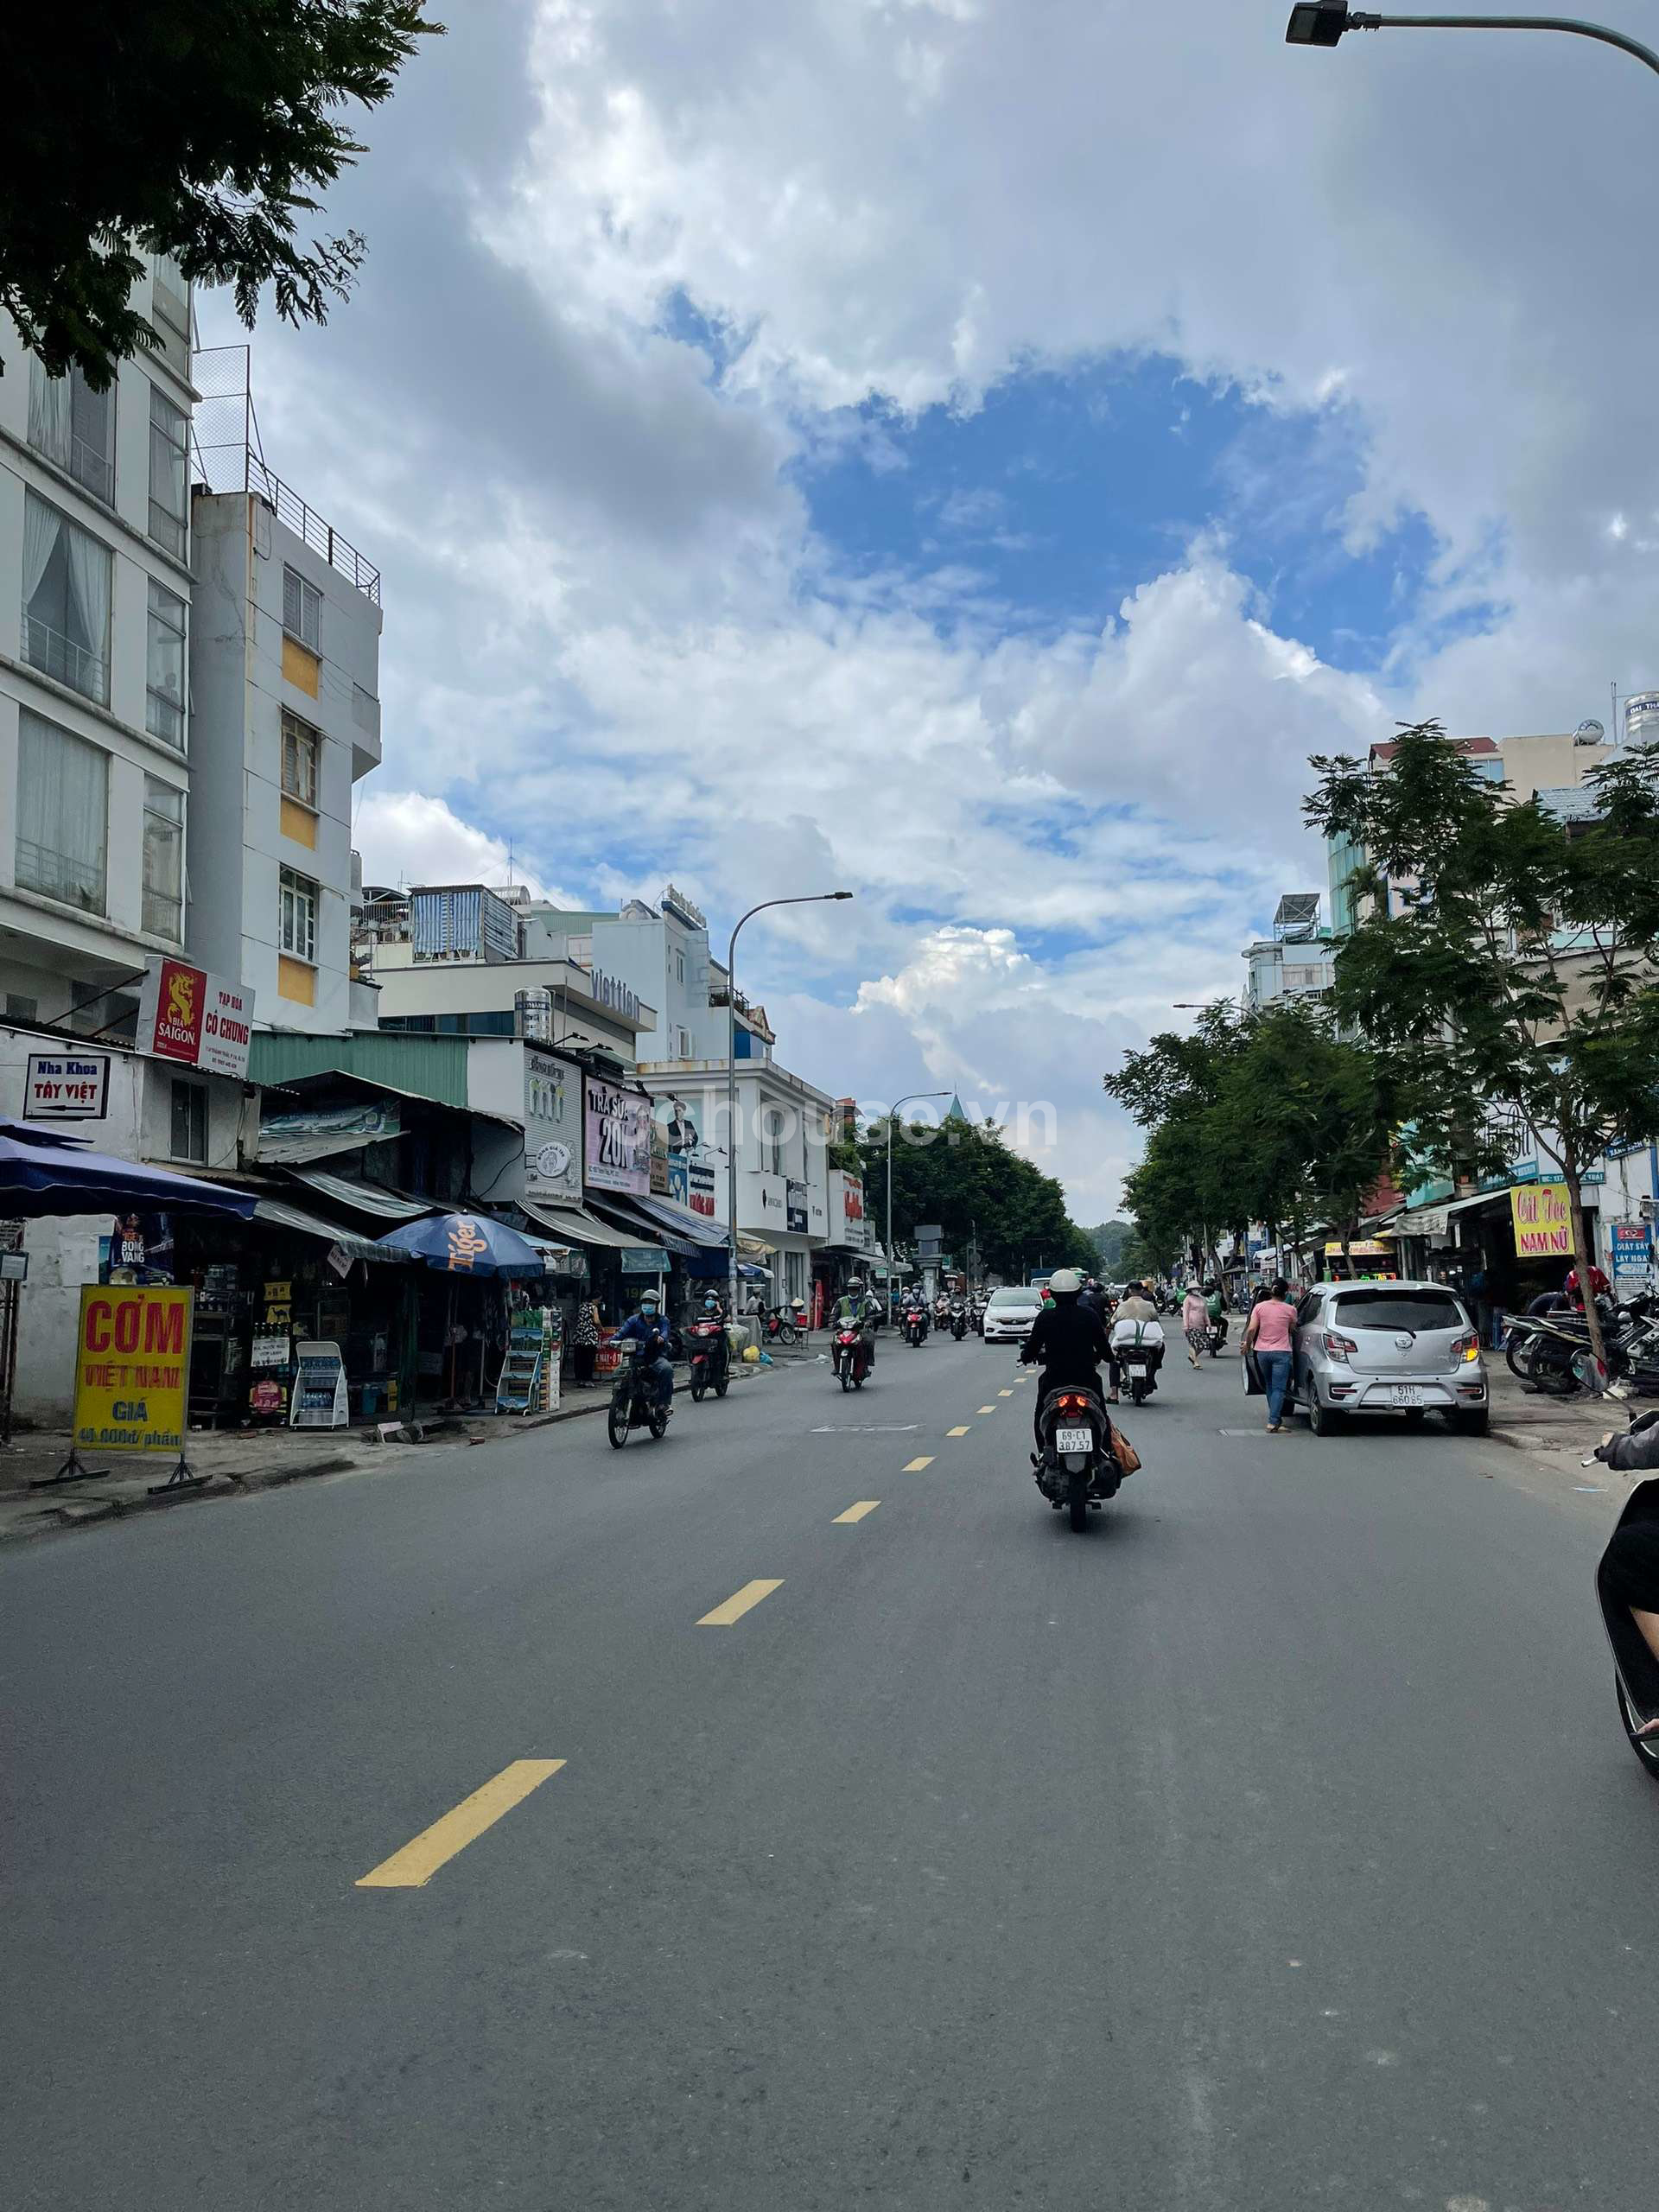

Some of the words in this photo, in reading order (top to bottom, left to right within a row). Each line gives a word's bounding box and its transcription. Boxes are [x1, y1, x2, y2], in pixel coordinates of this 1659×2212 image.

[158, 1022, 195, 1046] SAIGON
[173, 1017, 184, 1027] BIA
[219, 1017, 249, 1046] CHUNG
[37, 1061, 62, 1075] Nha
[66, 1061, 98, 1075] Khoa
[35, 1080, 62, 1099] TÂY
[65, 1081, 98, 1104] VIỆT
[588, 1086, 610, 1116] TRÀ
[600, 1117, 637, 1169] 20K
[448, 1219, 487, 1272] Tiger
[1521, 1232, 1549, 1253] NAM
[1550, 1225, 1569, 1253] NỮ
[86, 1294, 185, 1355] CƠM
[84, 1360, 129, 1392] VIỆT
[135, 1365, 181, 1389] NAM
[112, 1397, 148, 1422] GIÁ
